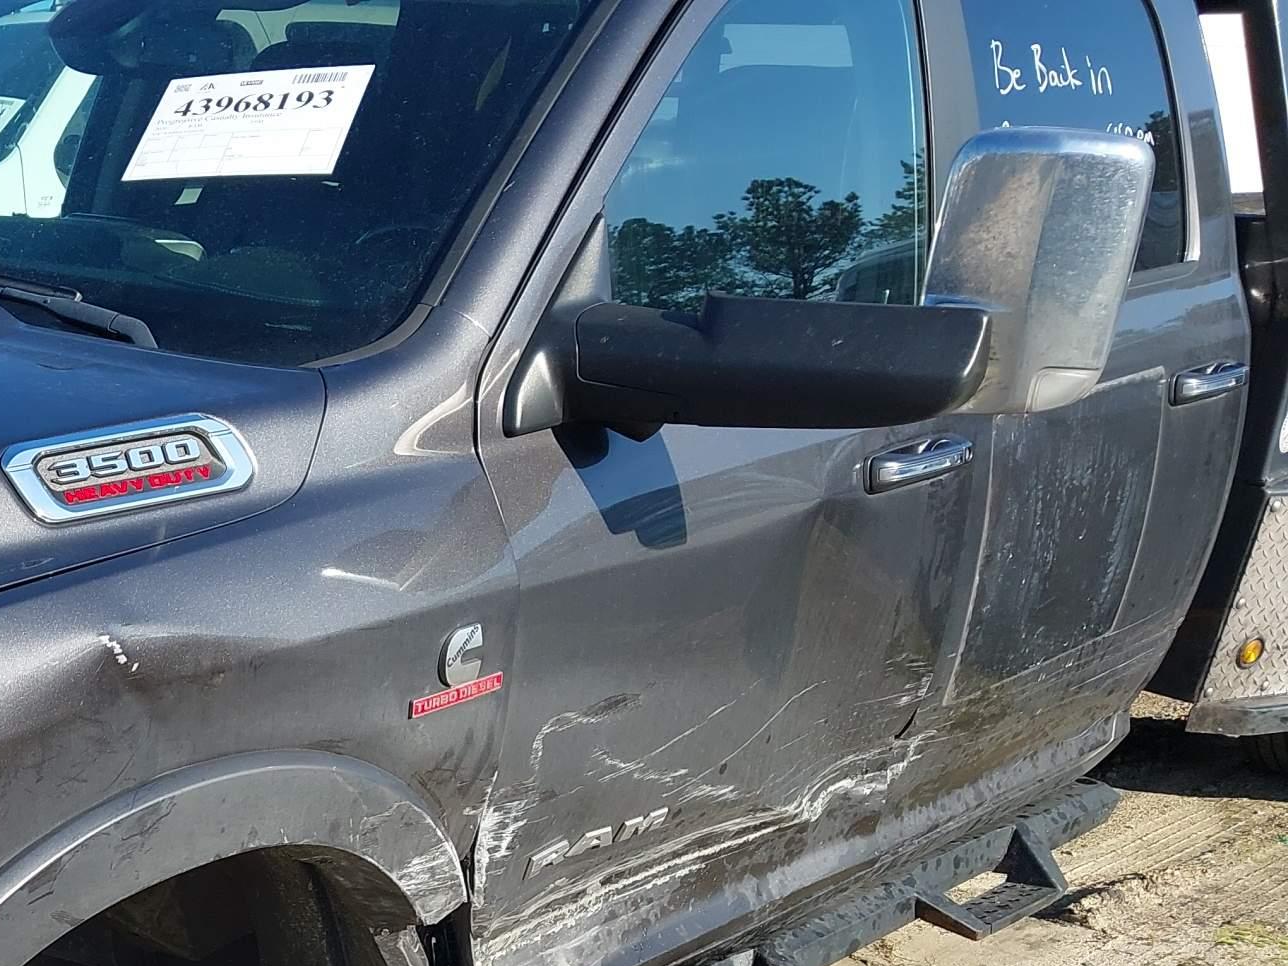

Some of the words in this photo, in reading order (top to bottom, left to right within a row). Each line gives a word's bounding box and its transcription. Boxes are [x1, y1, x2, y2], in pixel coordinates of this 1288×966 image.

[990, 39, 1026, 95] Be
[1030, 43, 1083, 93] Back
[1086, 55, 1113, 96] in
[173, 89, 335, 117] 43968193
[47, 438, 202, 485] 3500
[63, 475, 145, 505] HEAVY
[146, 463, 211, 487] DUTY
[445, 623, 480, 668] Cummins
[414, 690, 458, 714] TURBO
[459, 677, 502, 701] DIESEL
[522, 806, 670, 881] RAM
